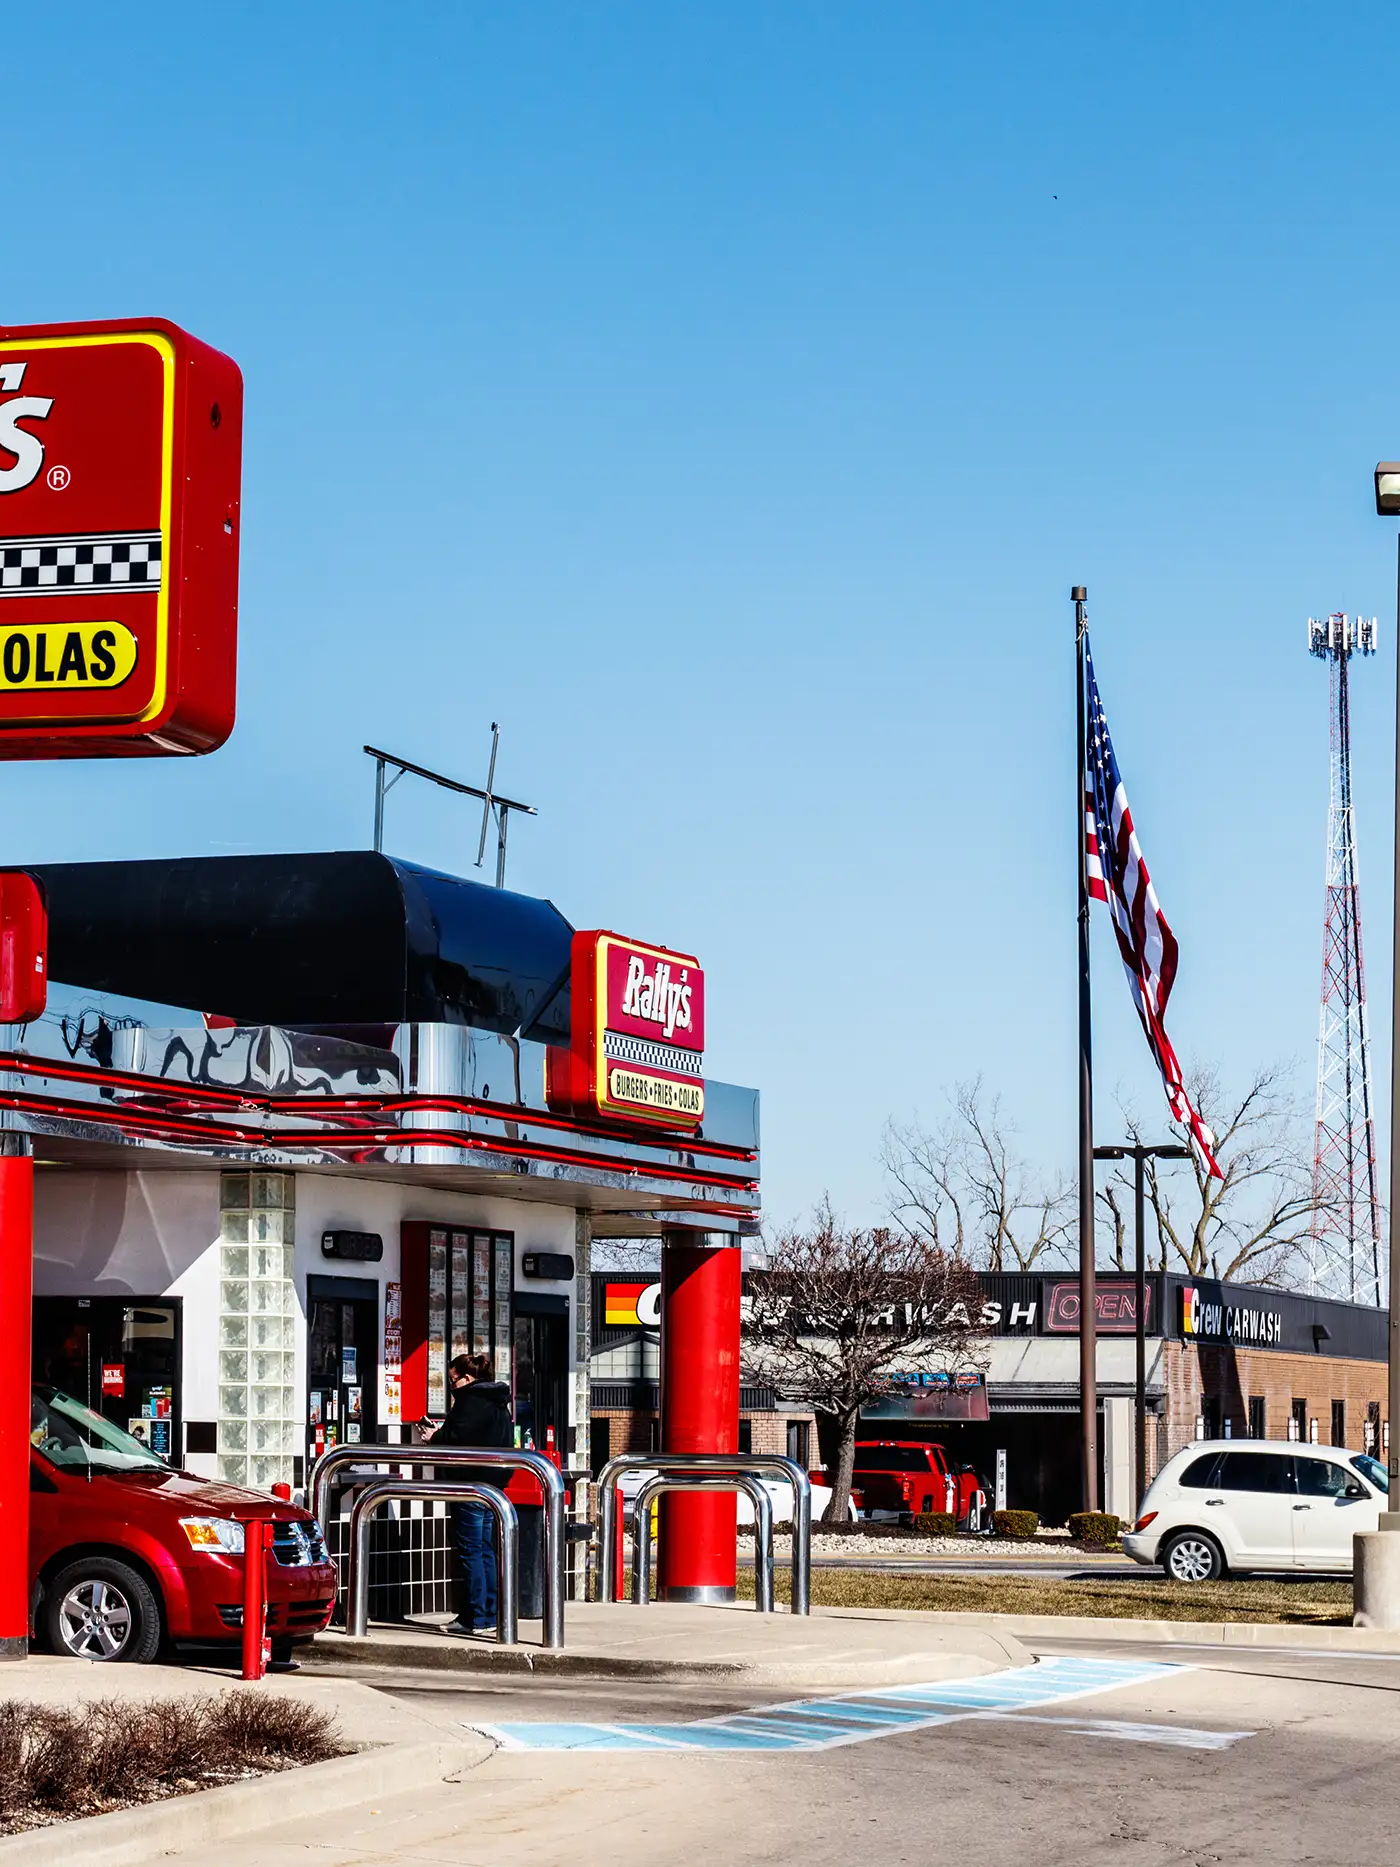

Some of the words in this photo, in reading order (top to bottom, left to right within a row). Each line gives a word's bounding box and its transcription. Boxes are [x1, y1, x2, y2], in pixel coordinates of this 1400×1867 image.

[622, 955, 692, 1038] Rally's
[616, 1074, 648, 1101] BURGERS
[653, 1082, 673, 1105] FRIES
[678, 1086, 700, 1111] COLAS
[1191, 1288, 1223, 1336] Crew
[1226, 1306, 1281, 1342] CARWASH
